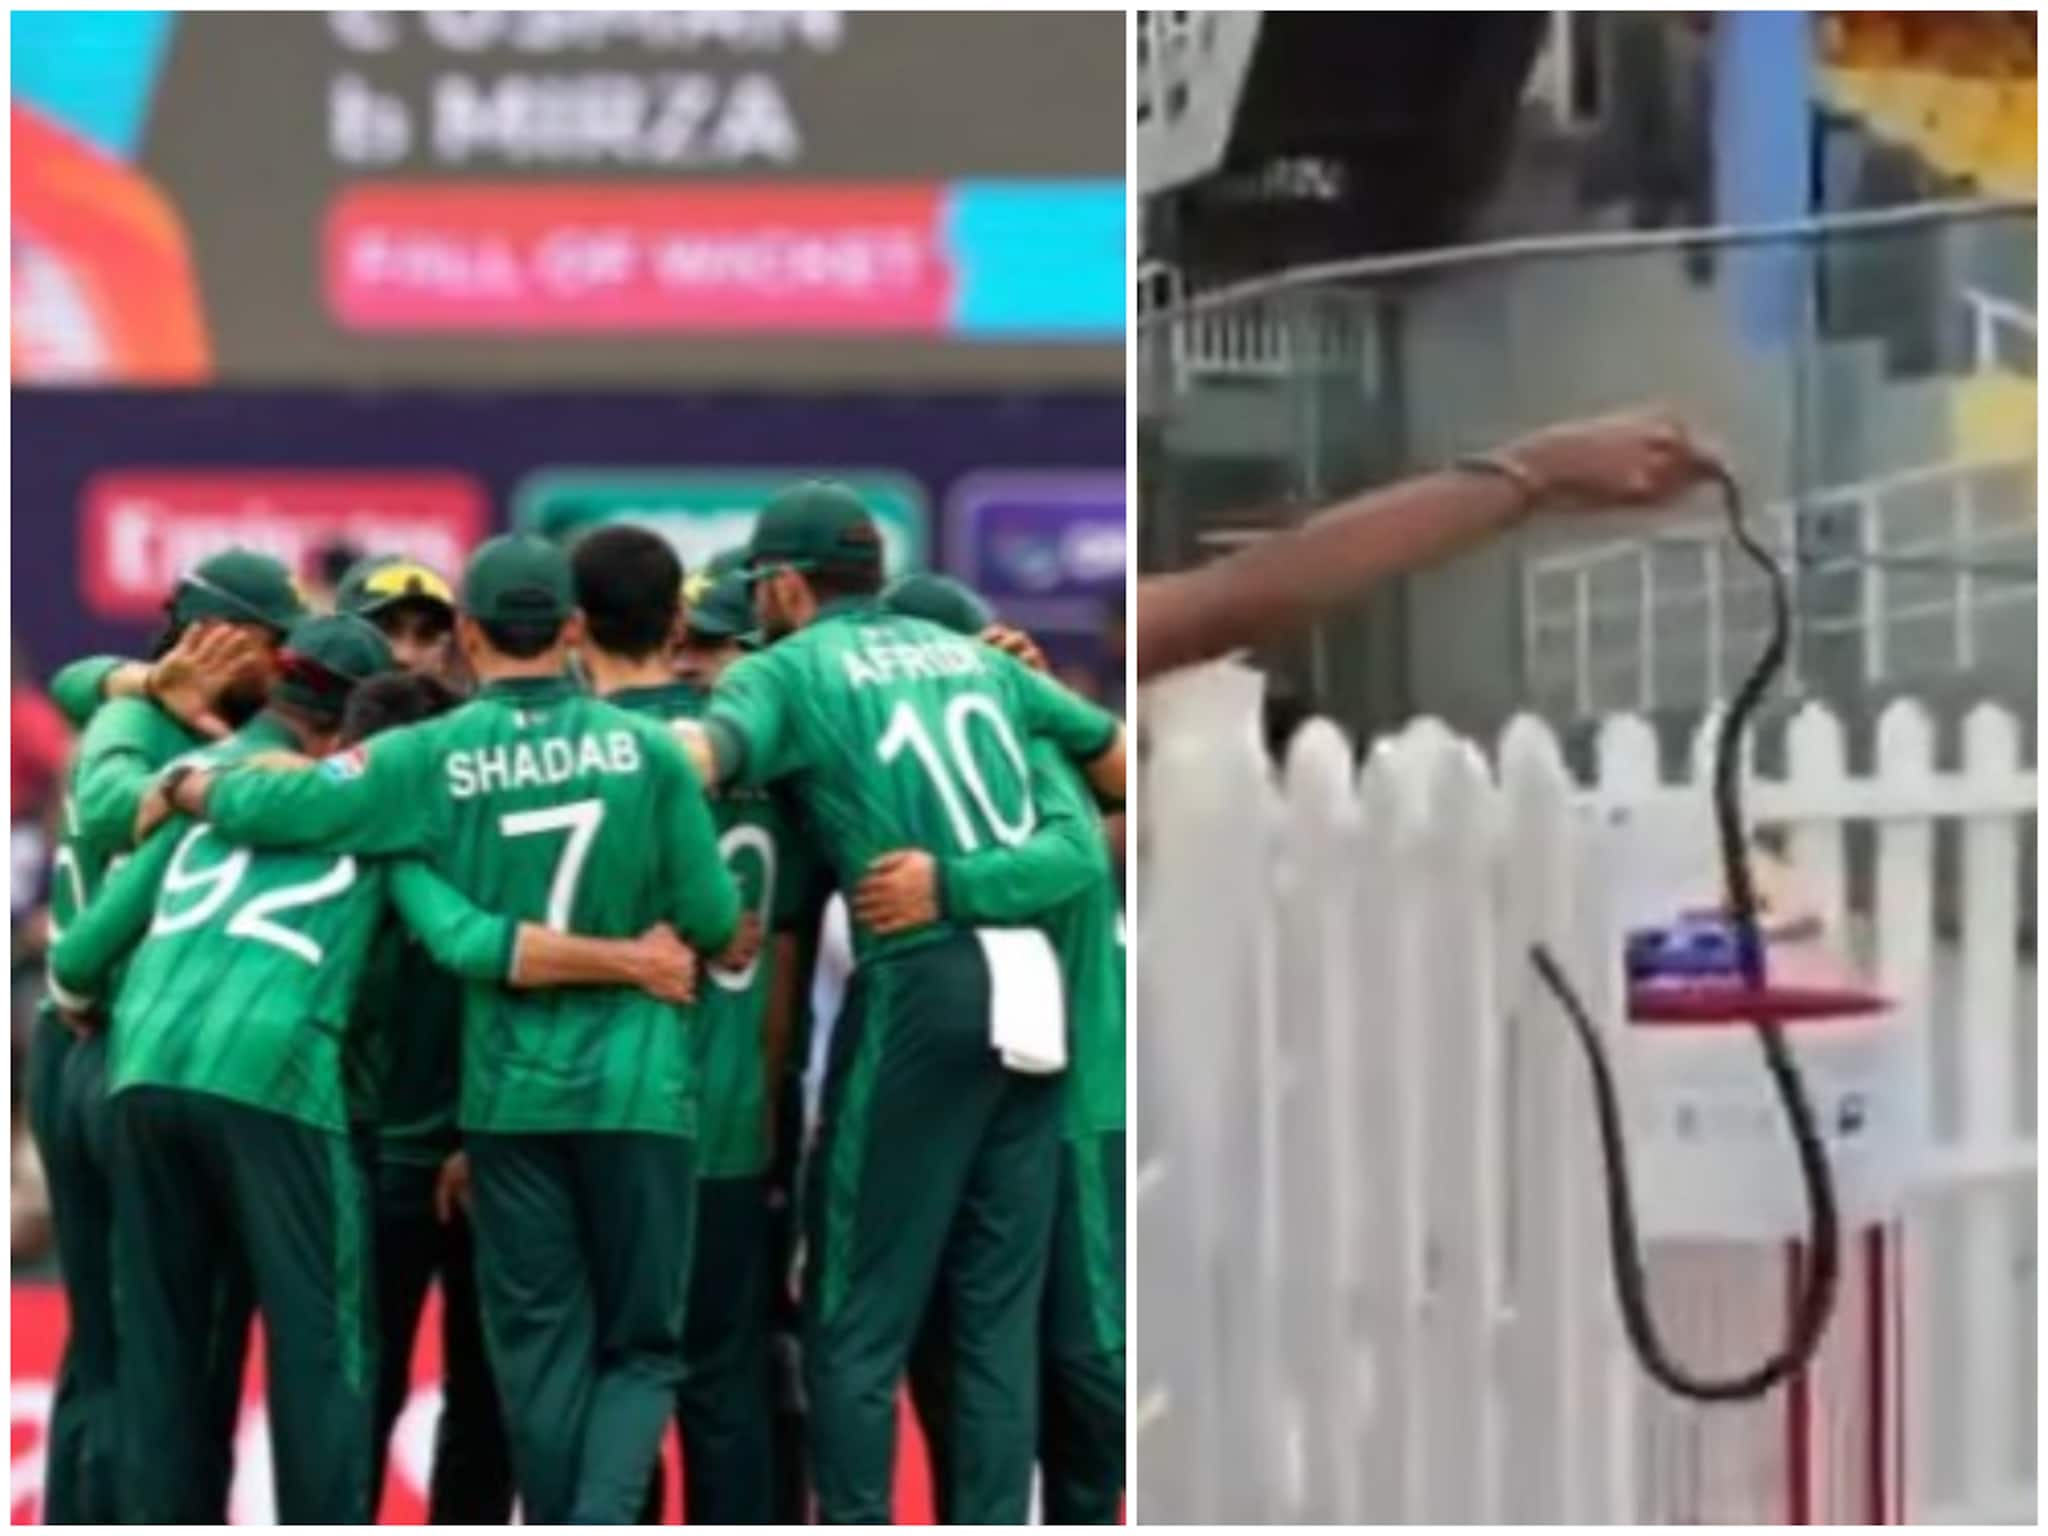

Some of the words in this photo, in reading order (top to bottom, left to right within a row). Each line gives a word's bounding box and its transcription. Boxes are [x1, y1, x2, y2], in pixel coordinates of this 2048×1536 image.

[432, 73, 801, 164] MIRZA
[532, 224, 633, 295] OF
[447, 732, 641, 798] SHADAB
[877, 693, 1036, 854] 10
[150, 822, 357, 966] 92
[500, 800, 604, 933] 7
